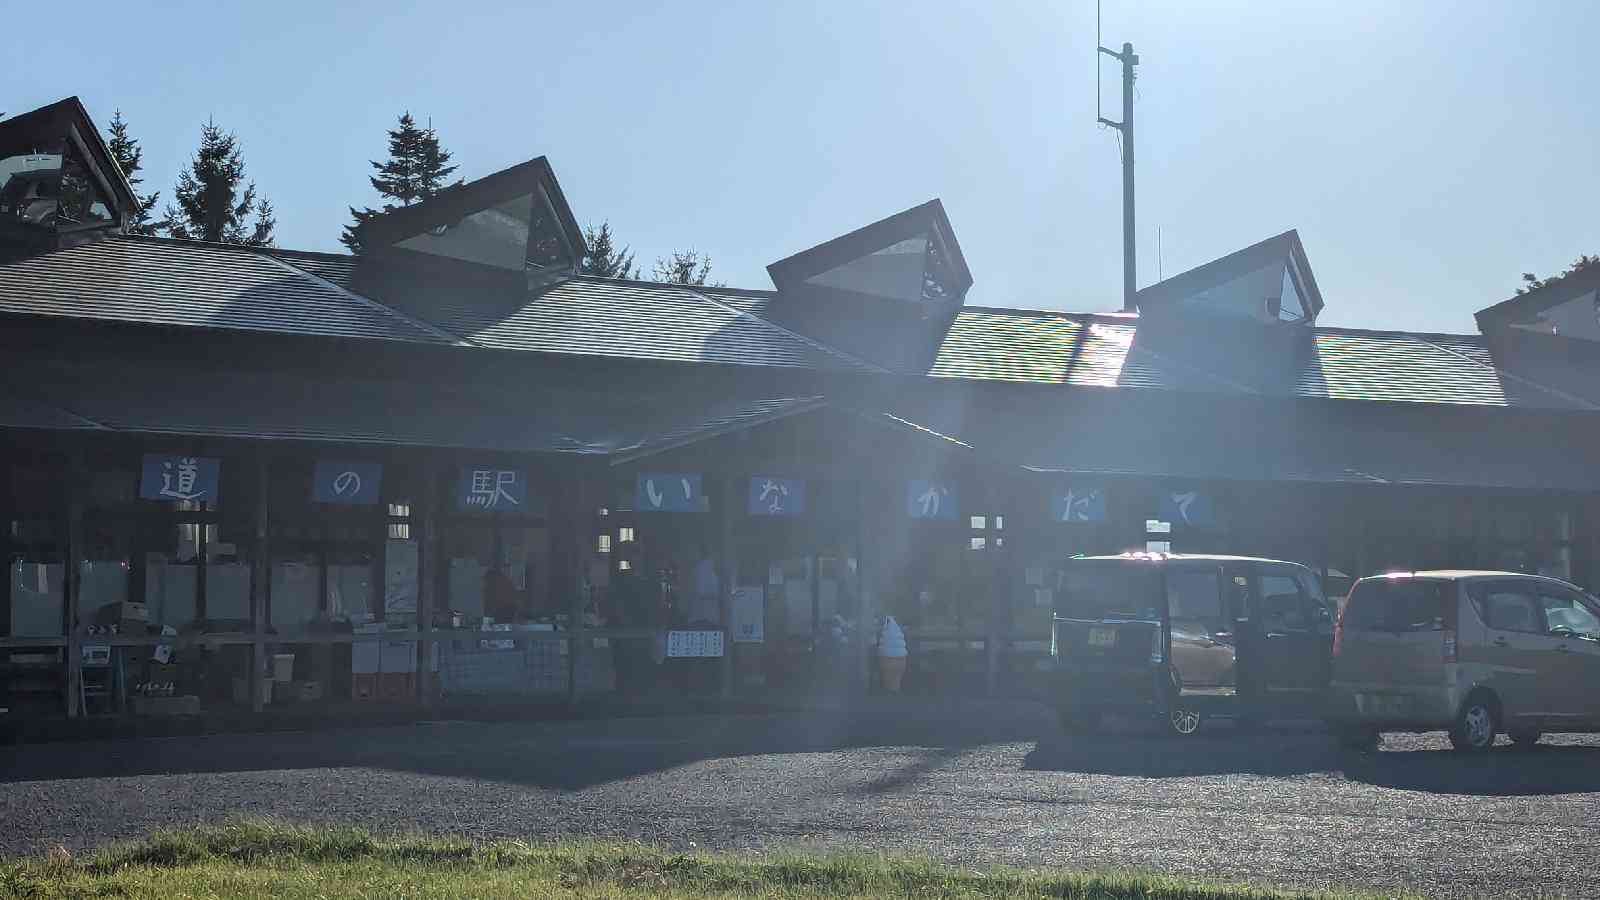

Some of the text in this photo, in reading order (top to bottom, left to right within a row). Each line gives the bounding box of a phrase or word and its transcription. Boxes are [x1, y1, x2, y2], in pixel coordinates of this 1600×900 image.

[161, 458, 207, 500] 道
[334, 471, 361, 496] の
[466, 471, 519, 508] 駅
[647, 479, 691, 507] い
[760, 479, 788, 514] な
[917, 487, 948, 516] か
[1063, 488, 1097, 521] だ
